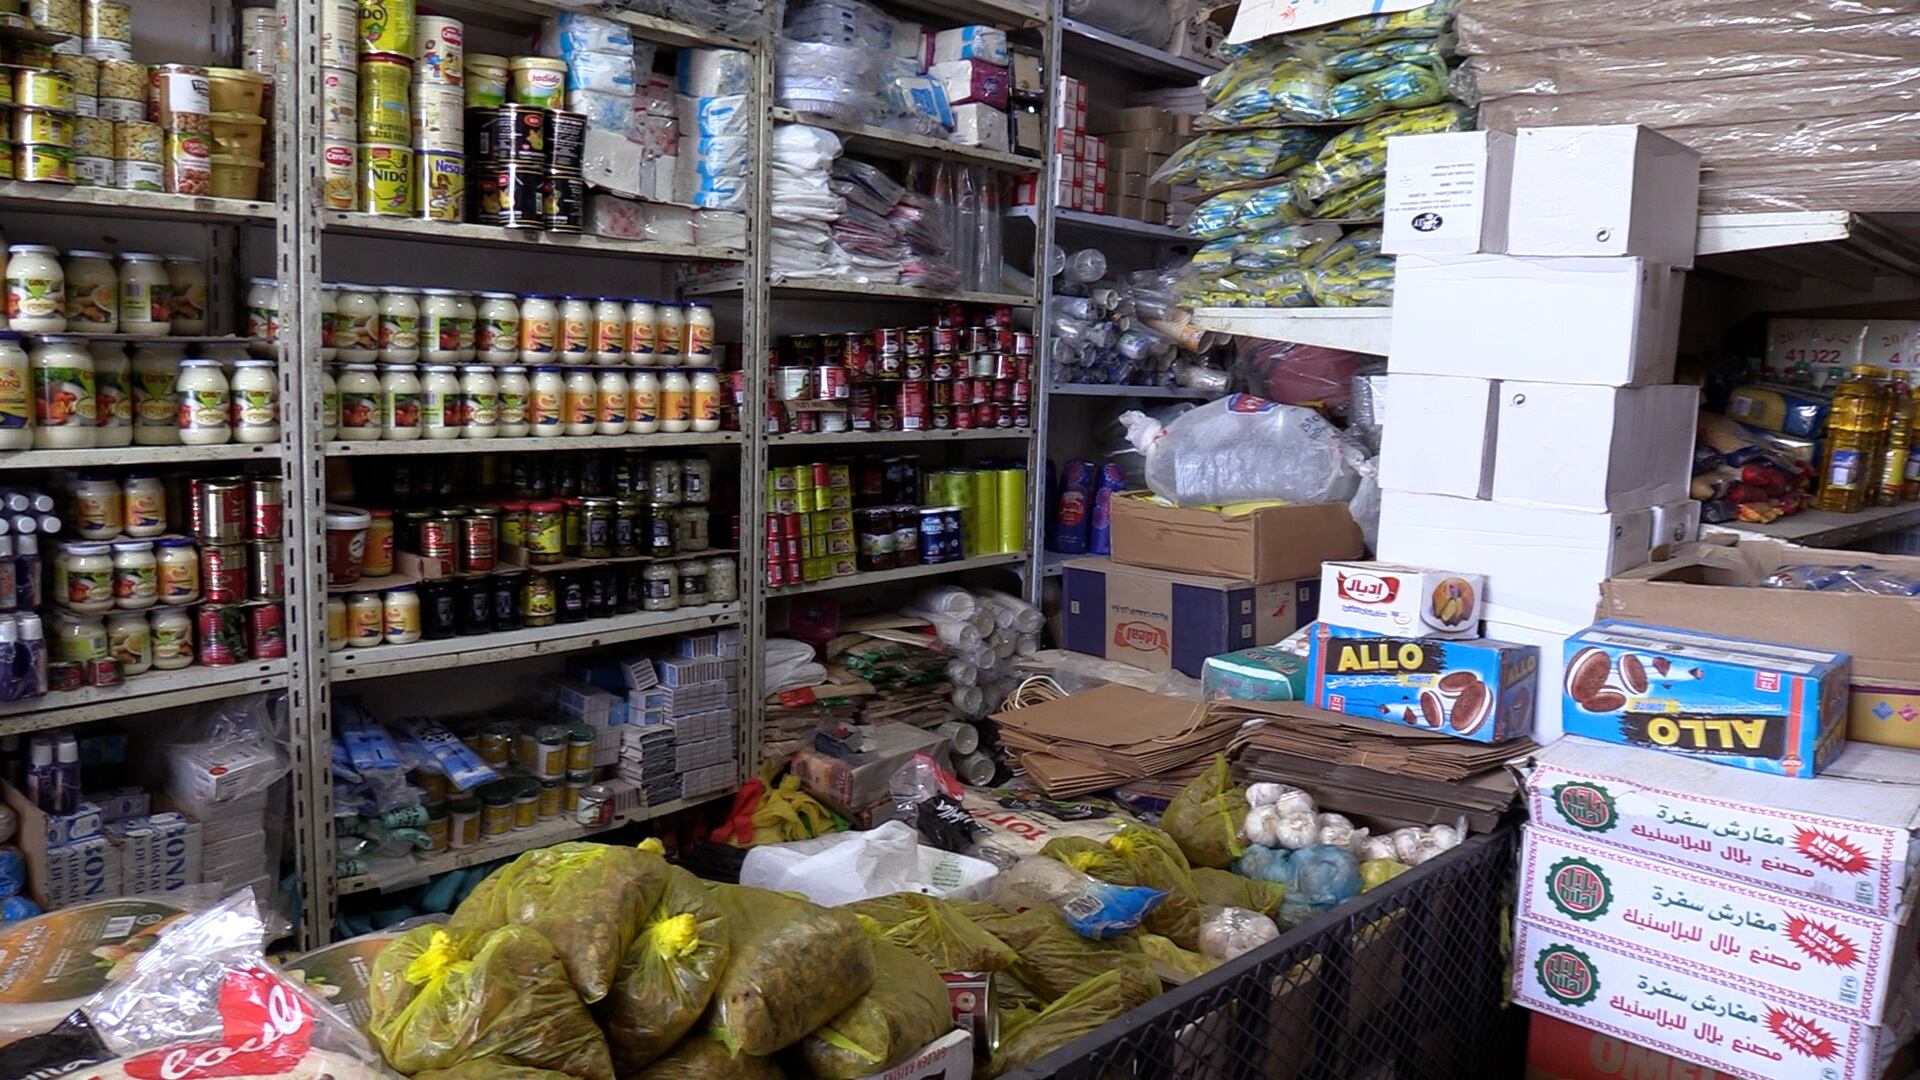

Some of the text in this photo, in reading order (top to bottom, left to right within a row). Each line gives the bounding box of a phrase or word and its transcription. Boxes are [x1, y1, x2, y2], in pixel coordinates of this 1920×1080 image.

[373, 168, 408, 183] NIDO
[1338, 643, 1424, 672] ALLO
[1648, 717, 1768, 749] ALLO
[1656, 805, 1784, 845] مفارش سفرة
[1720, 846, 1752, 866] بلال
[1812, 835, 1855, 863] NEW
[1761, 856, 1814, 877] مصنع
[1652, 886, 1777, 931] مفارش سفرة
[1710, 933, 1741, 957] بلال
[1802, 924, 1844, 953] NEW
[1749, 946, 1802, 971] مصنع
[1637, 974, 1758, 1023] مفارش سفرة
[1694, 1022, 1724, 1046] بلال
[1782, 1016, 1823, 1047] NEW
[1731, 1036, 1783, 1062] مصنع
